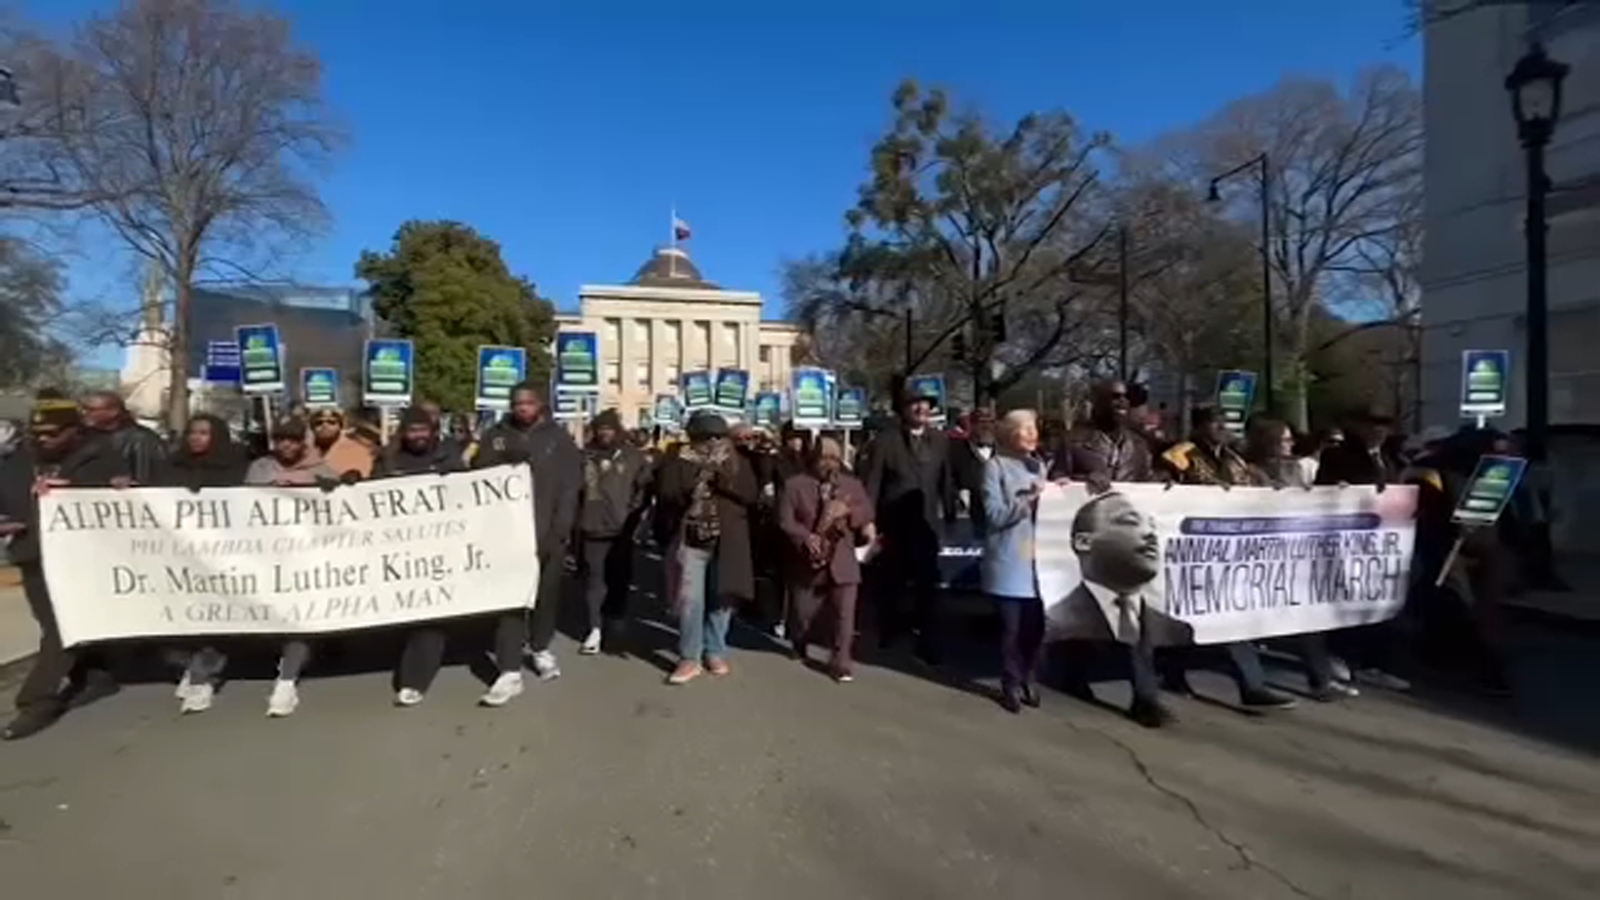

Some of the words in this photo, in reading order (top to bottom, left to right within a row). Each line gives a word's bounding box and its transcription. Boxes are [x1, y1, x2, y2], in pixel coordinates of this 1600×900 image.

[48, 500, 160, 532] ALPHA
[175, 499, 231, 529] PHI
[248, 496, 358, 527] ALPHA
[471, 474, 529, 507] INC.
[131, 539, 164, 556] PHI
[171, 539, 263, 556] LAMBDA
[272, 528, 374, 555] CHAPTER
[380, 518, 468, 543] SALUTES
[1164, 537, 1233, 563] ANNUAL
[1235, 536, 1288, 562] MARTIN
[1289, 532, 1341, 560] LUTHER
[111, 565, 155, 595] Dr.
[166, 565, 257, 595] Martin
[273, 560, 369, 594] Luther
[464, 543, 491, 572] Jr.
[1164, 561, 1301, 616] MEMORIAL
[1308, 556, 1401, 606] MARCH
[161, 604, 174, 622] A
[186, 603, 273, 622] GREAT
[281, 595, 380, 624] ALPHA
[395, 586, 456, 611] MAN
